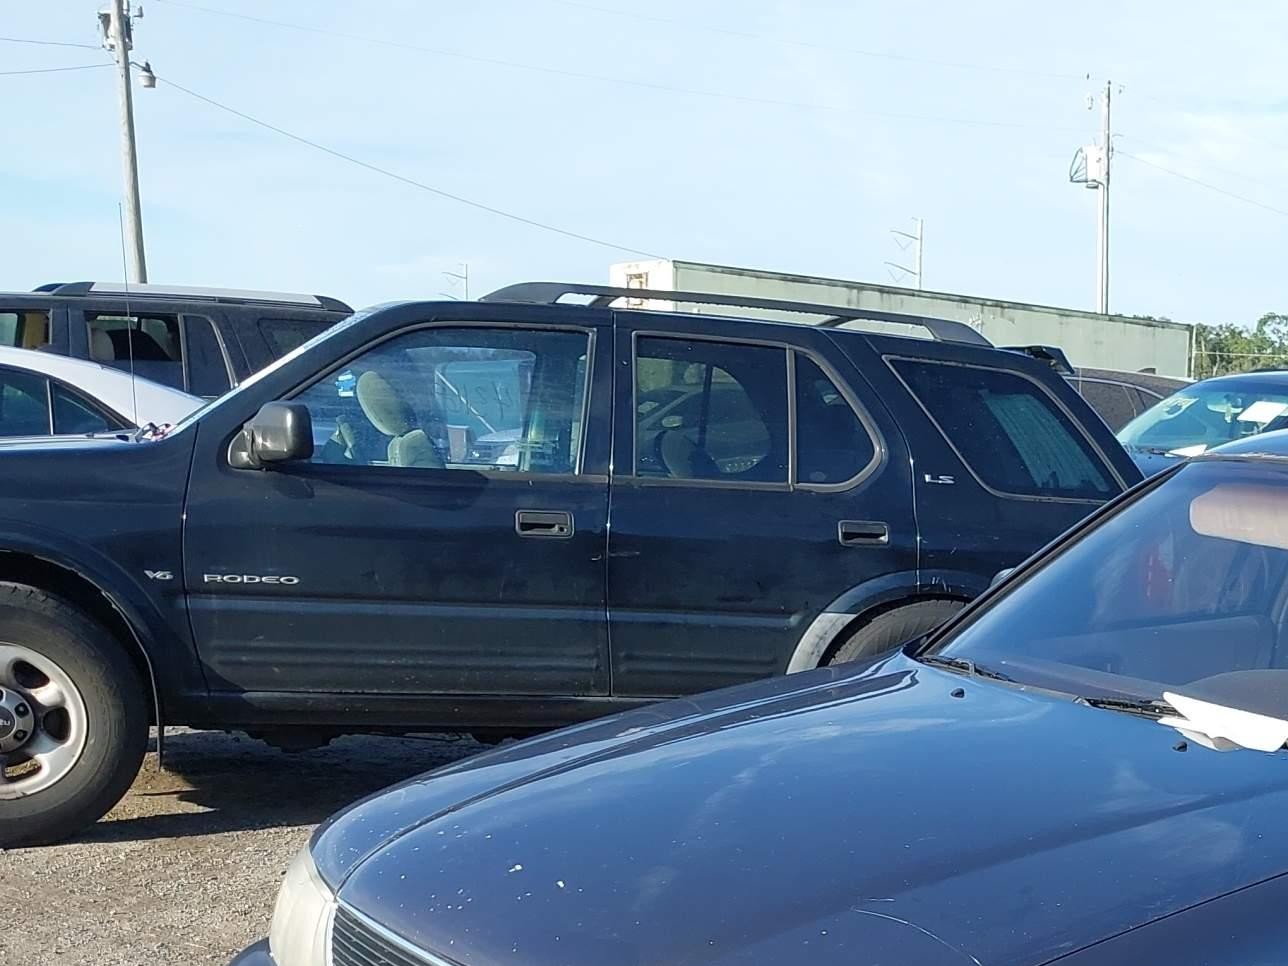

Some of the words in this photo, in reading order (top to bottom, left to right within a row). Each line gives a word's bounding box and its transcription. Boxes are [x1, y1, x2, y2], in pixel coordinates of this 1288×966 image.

[924, 474, 955, 484] LS
[144, 570, 173, 580] V6
[203, 574, 300, 584] RODEO
